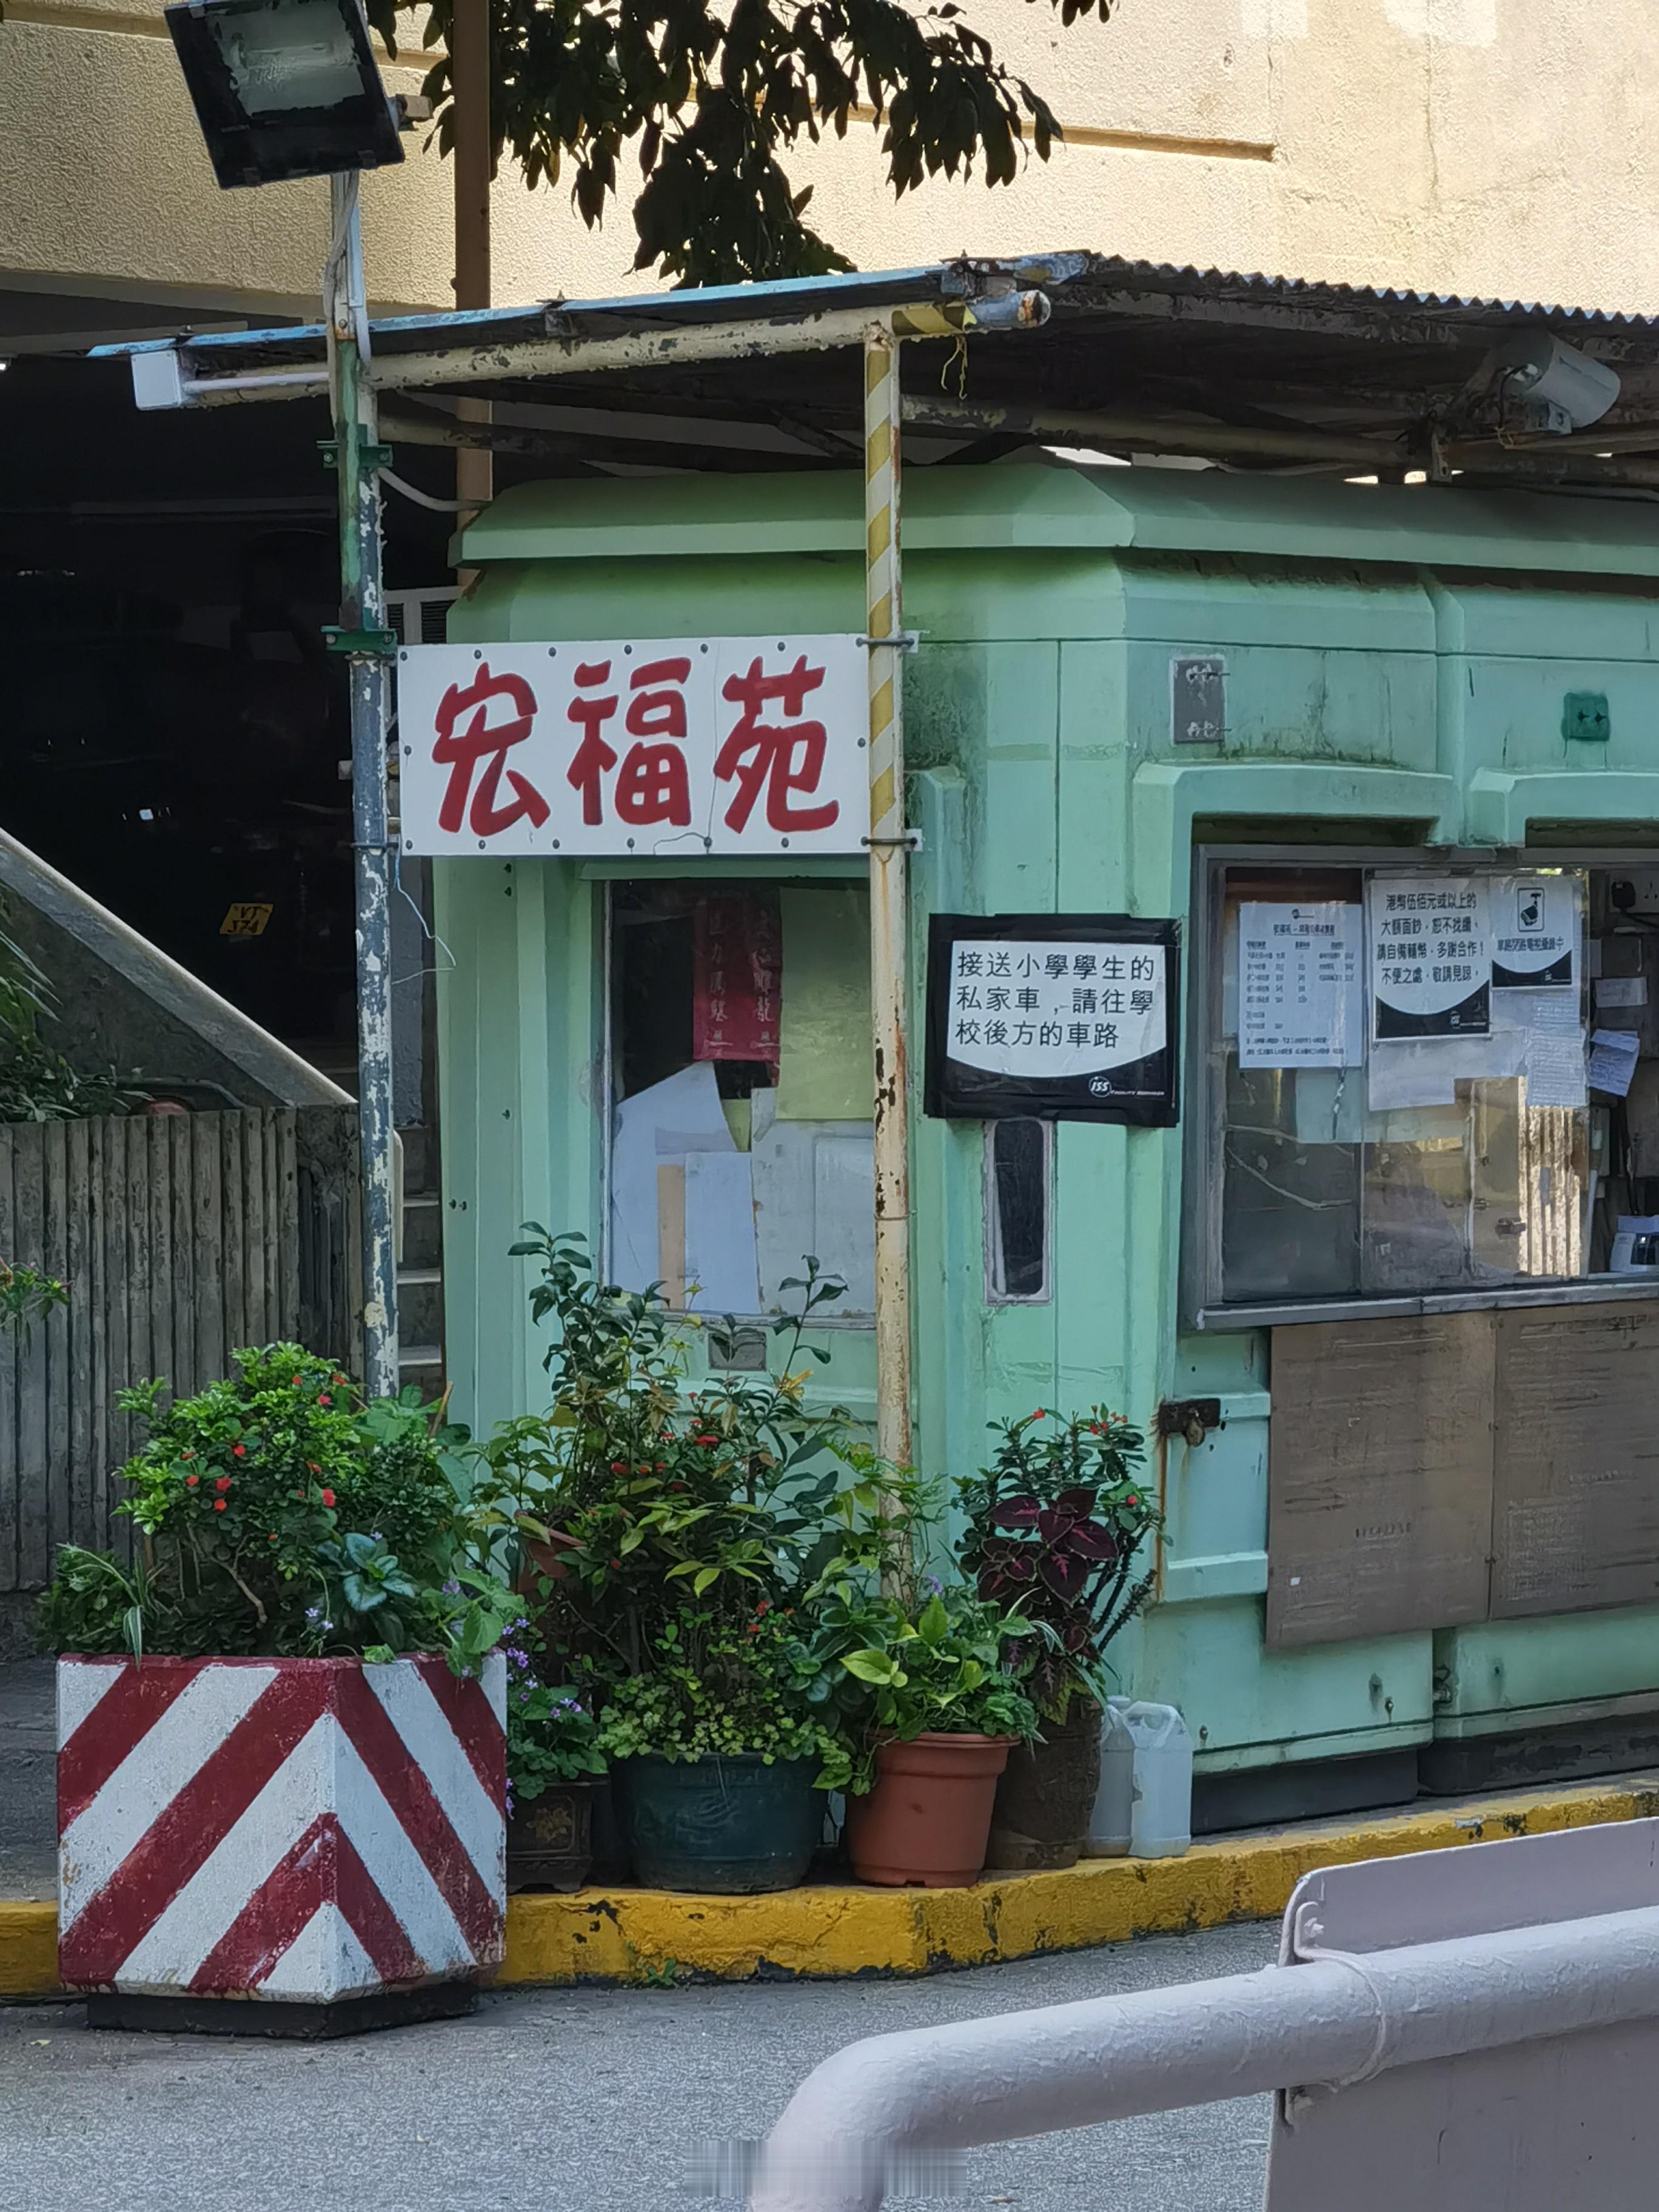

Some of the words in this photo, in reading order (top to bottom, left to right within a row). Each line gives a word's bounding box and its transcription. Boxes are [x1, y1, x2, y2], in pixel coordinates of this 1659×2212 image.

[432, 654, 840, 837] 宏福苑
[957, 951, 1155, 980] 接送小學學生的
[956, 985, 1154, 1016] 私家車，請往學
[955, 1019, 1119, 1048] 校後方的車路
